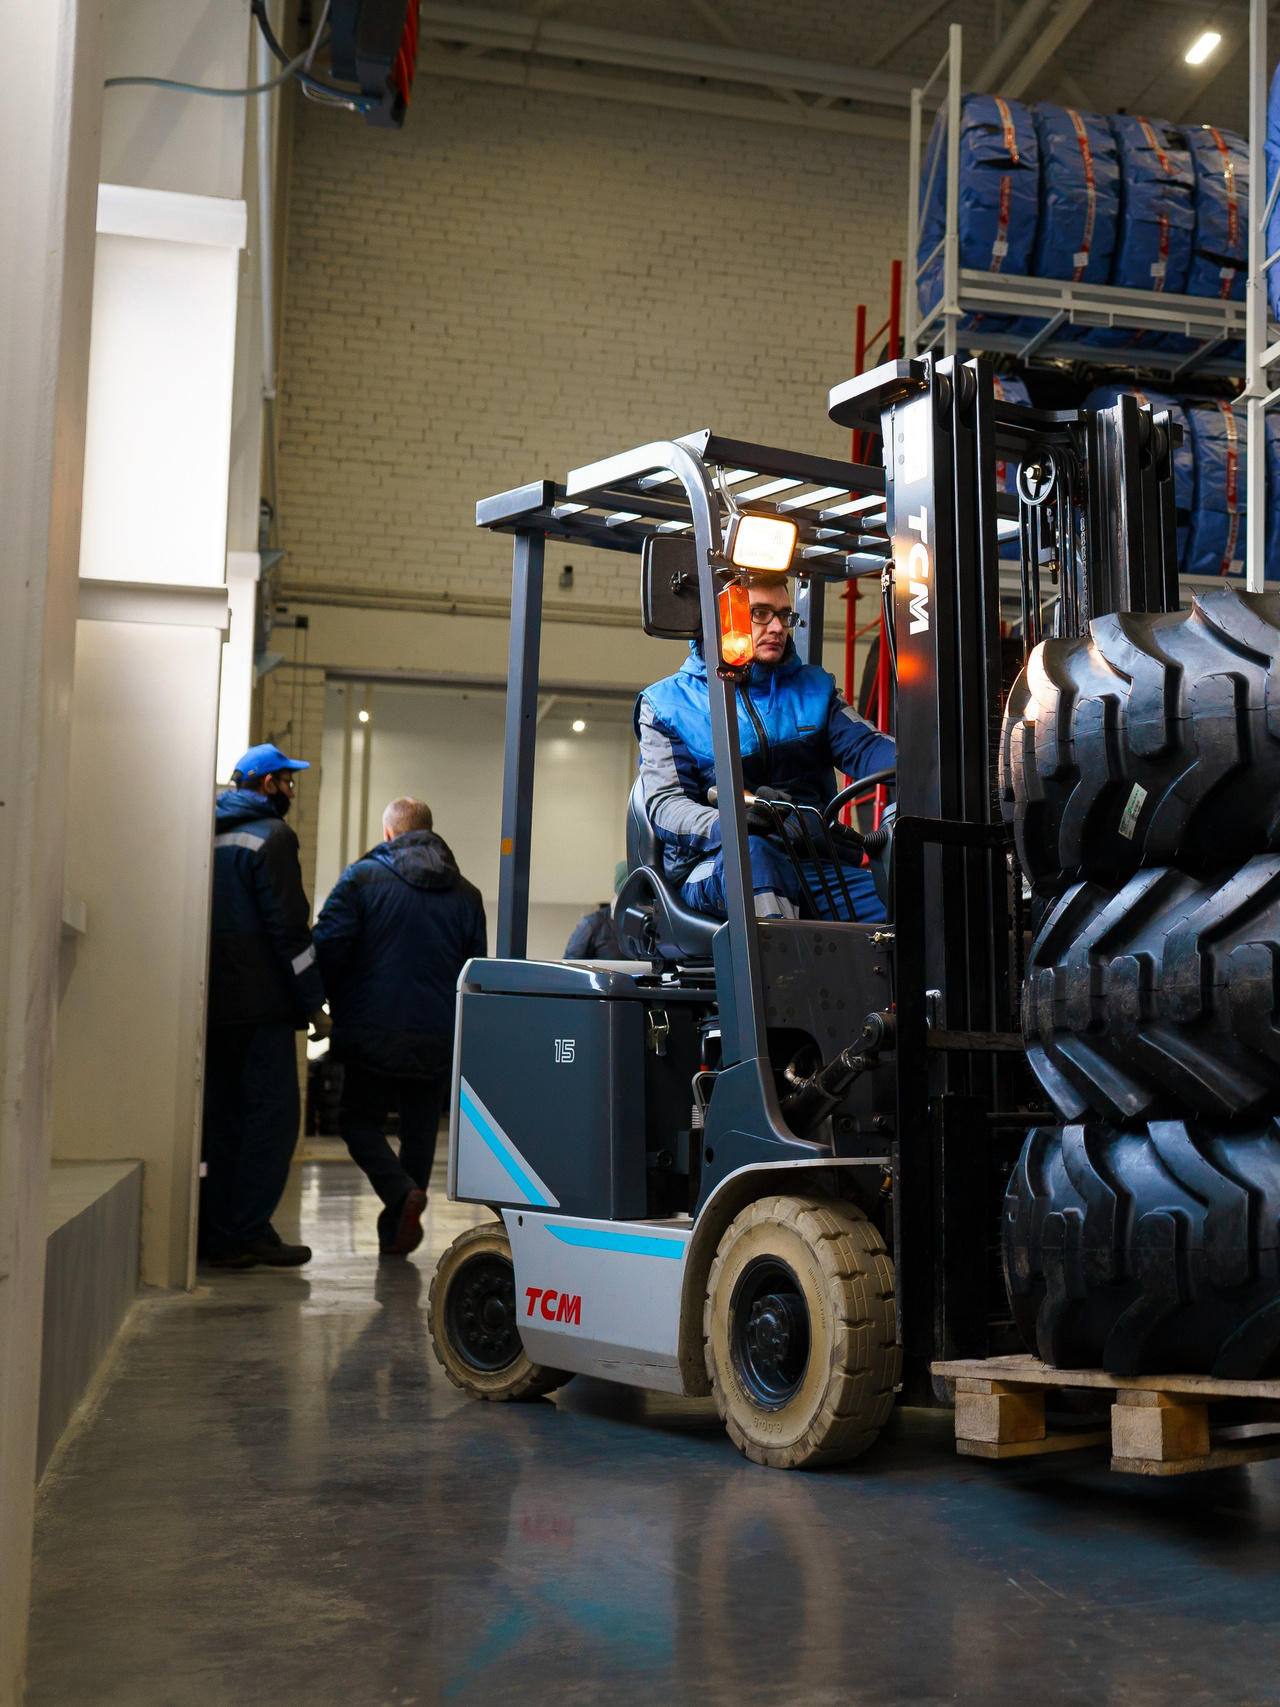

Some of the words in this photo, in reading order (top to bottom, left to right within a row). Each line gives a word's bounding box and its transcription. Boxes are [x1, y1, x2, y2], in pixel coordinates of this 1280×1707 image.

[908, 504, 930, 635] TCM
[553, 1038, 576, 1064] 15
[525, 1287, 582, 1325] TCM
